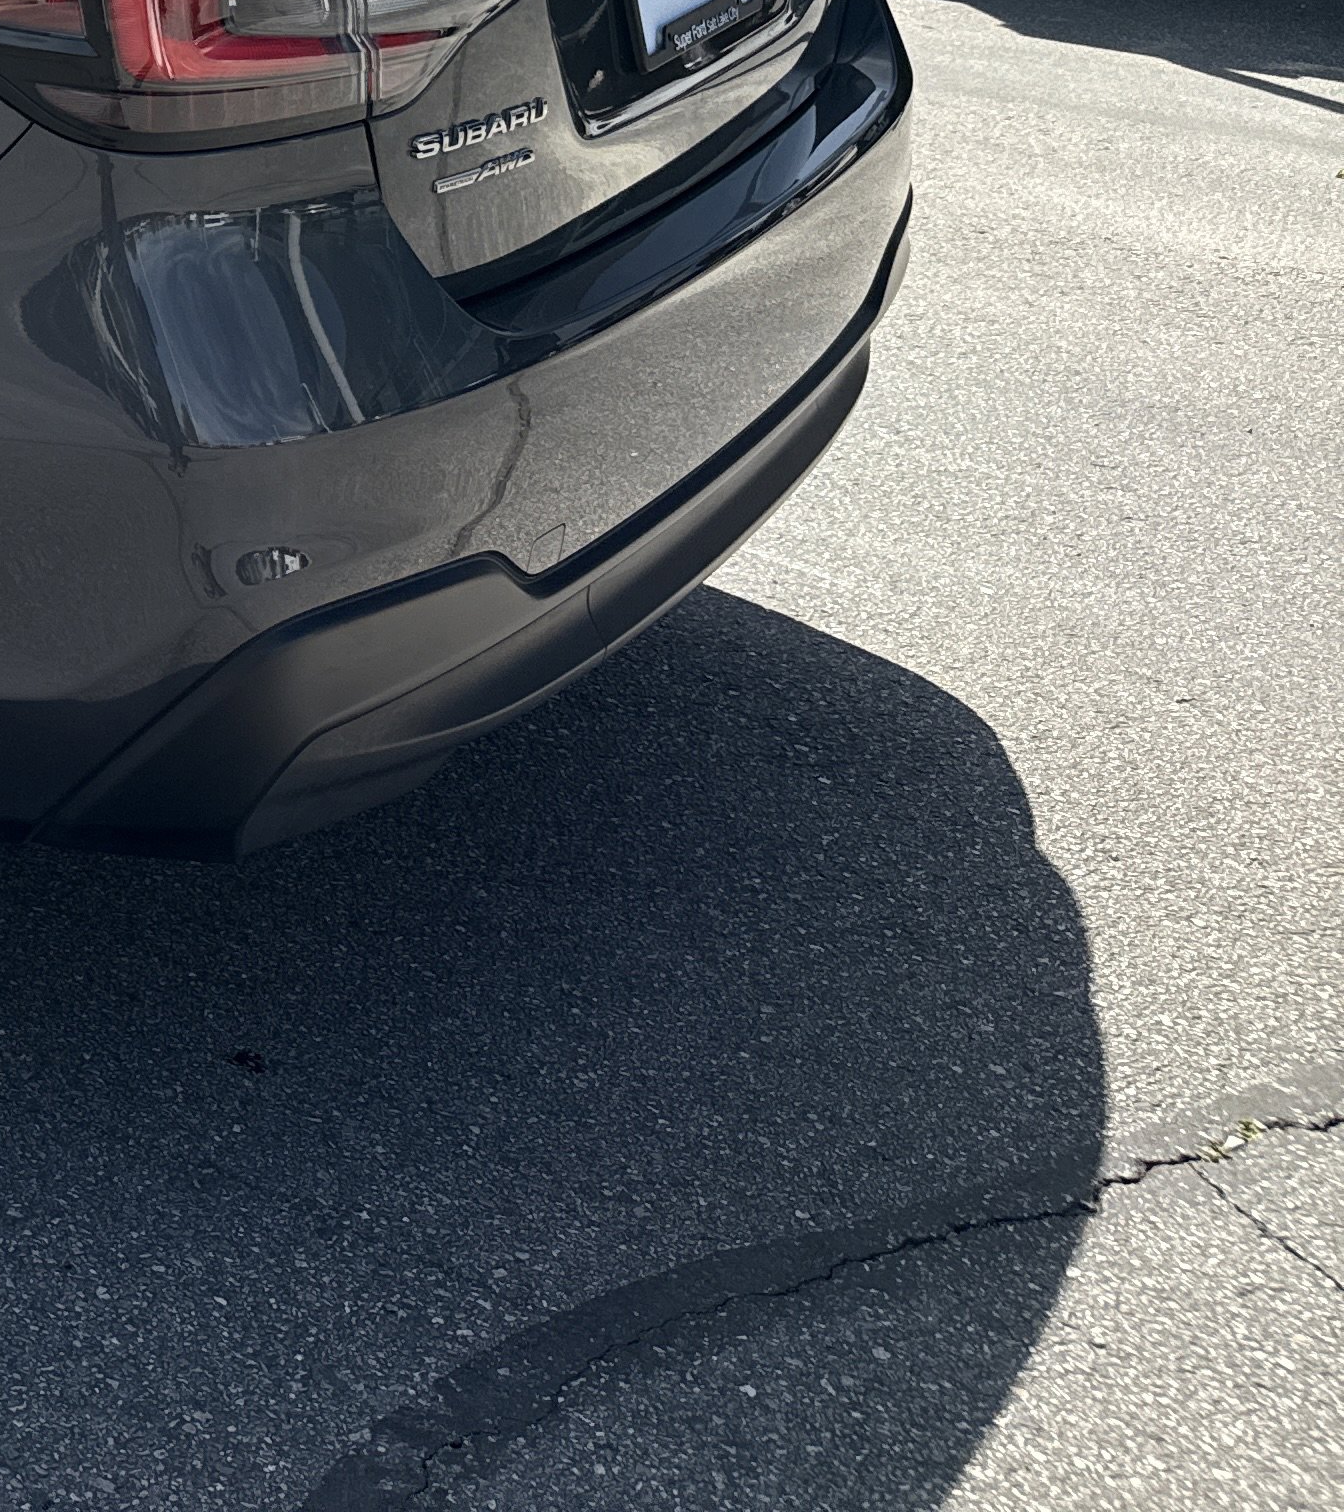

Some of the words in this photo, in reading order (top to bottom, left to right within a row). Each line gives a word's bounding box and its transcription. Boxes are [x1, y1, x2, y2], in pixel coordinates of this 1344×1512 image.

[673, 31, 692, 51] Super
[691, 22, 706, 41] Ford
[706, 17, 716, 33] Salt
[716, 11, 729, 28] Lake
[727, 6, 740, 22] City
[412, 97, 548, 159] SUBARU
[477, 148, 536, 181] AWD
